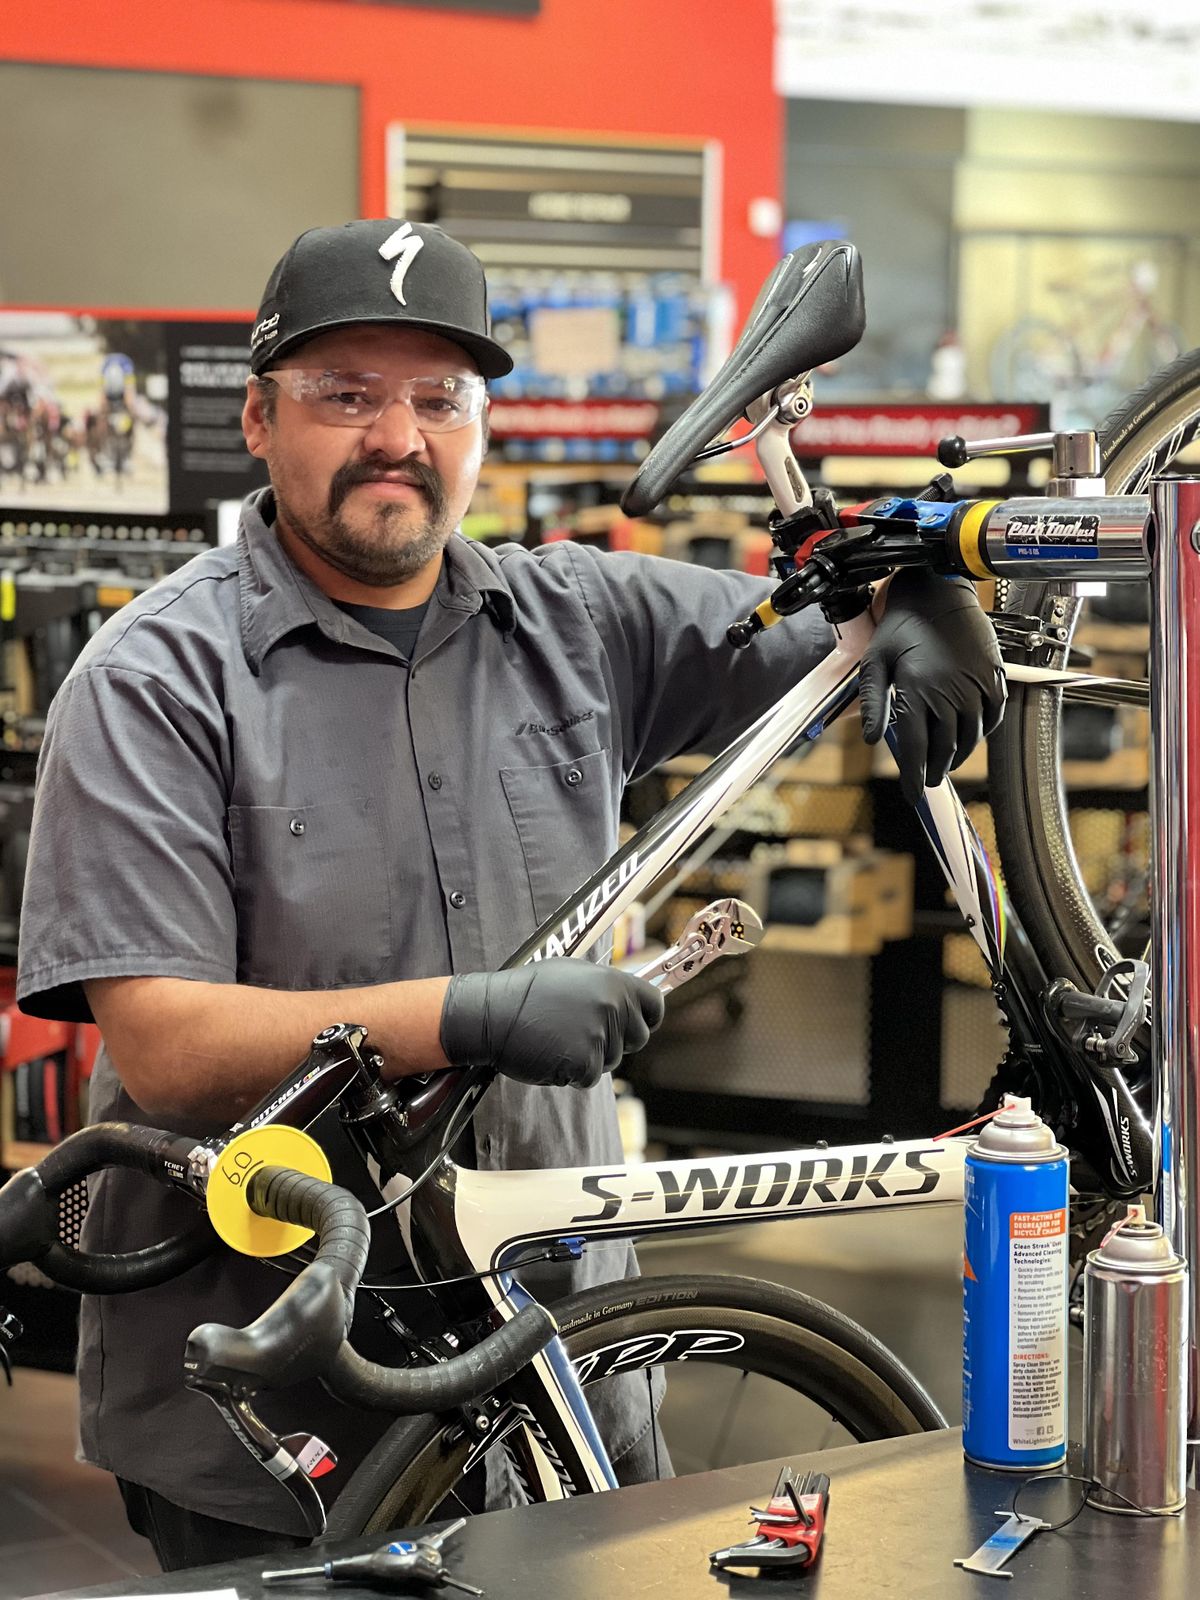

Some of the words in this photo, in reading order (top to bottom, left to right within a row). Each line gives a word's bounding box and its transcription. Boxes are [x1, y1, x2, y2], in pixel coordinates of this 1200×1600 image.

[1102, 429, 1128, 460] Handmade
[1133, 401, 1156, 424] Germany
[1007, 521, 1043, 537] Park
[1045, 521, 1081, 537] Tool
[251, 1080, 302, 1128] RITCHEY
[1120, 1116, 1137, 1177] S-WORKS
[164, 1160, 185, 1172] TCHEY
[570, 1149, 946, 1223] S-WORKS
[1013, 1221, 1050, 1229] DEGREASER
[1051, 1219, 1061, 1227] FOR
[1014, 1214, 1053, 1222] FAST-ACTING
[1013, 1229, 1041, 1237] BICYCLE
[593, 1310, 601, 1319] in
[602, 1300, 634, 1316] Germany
[635, 1289, 699, 1307] EDITION
